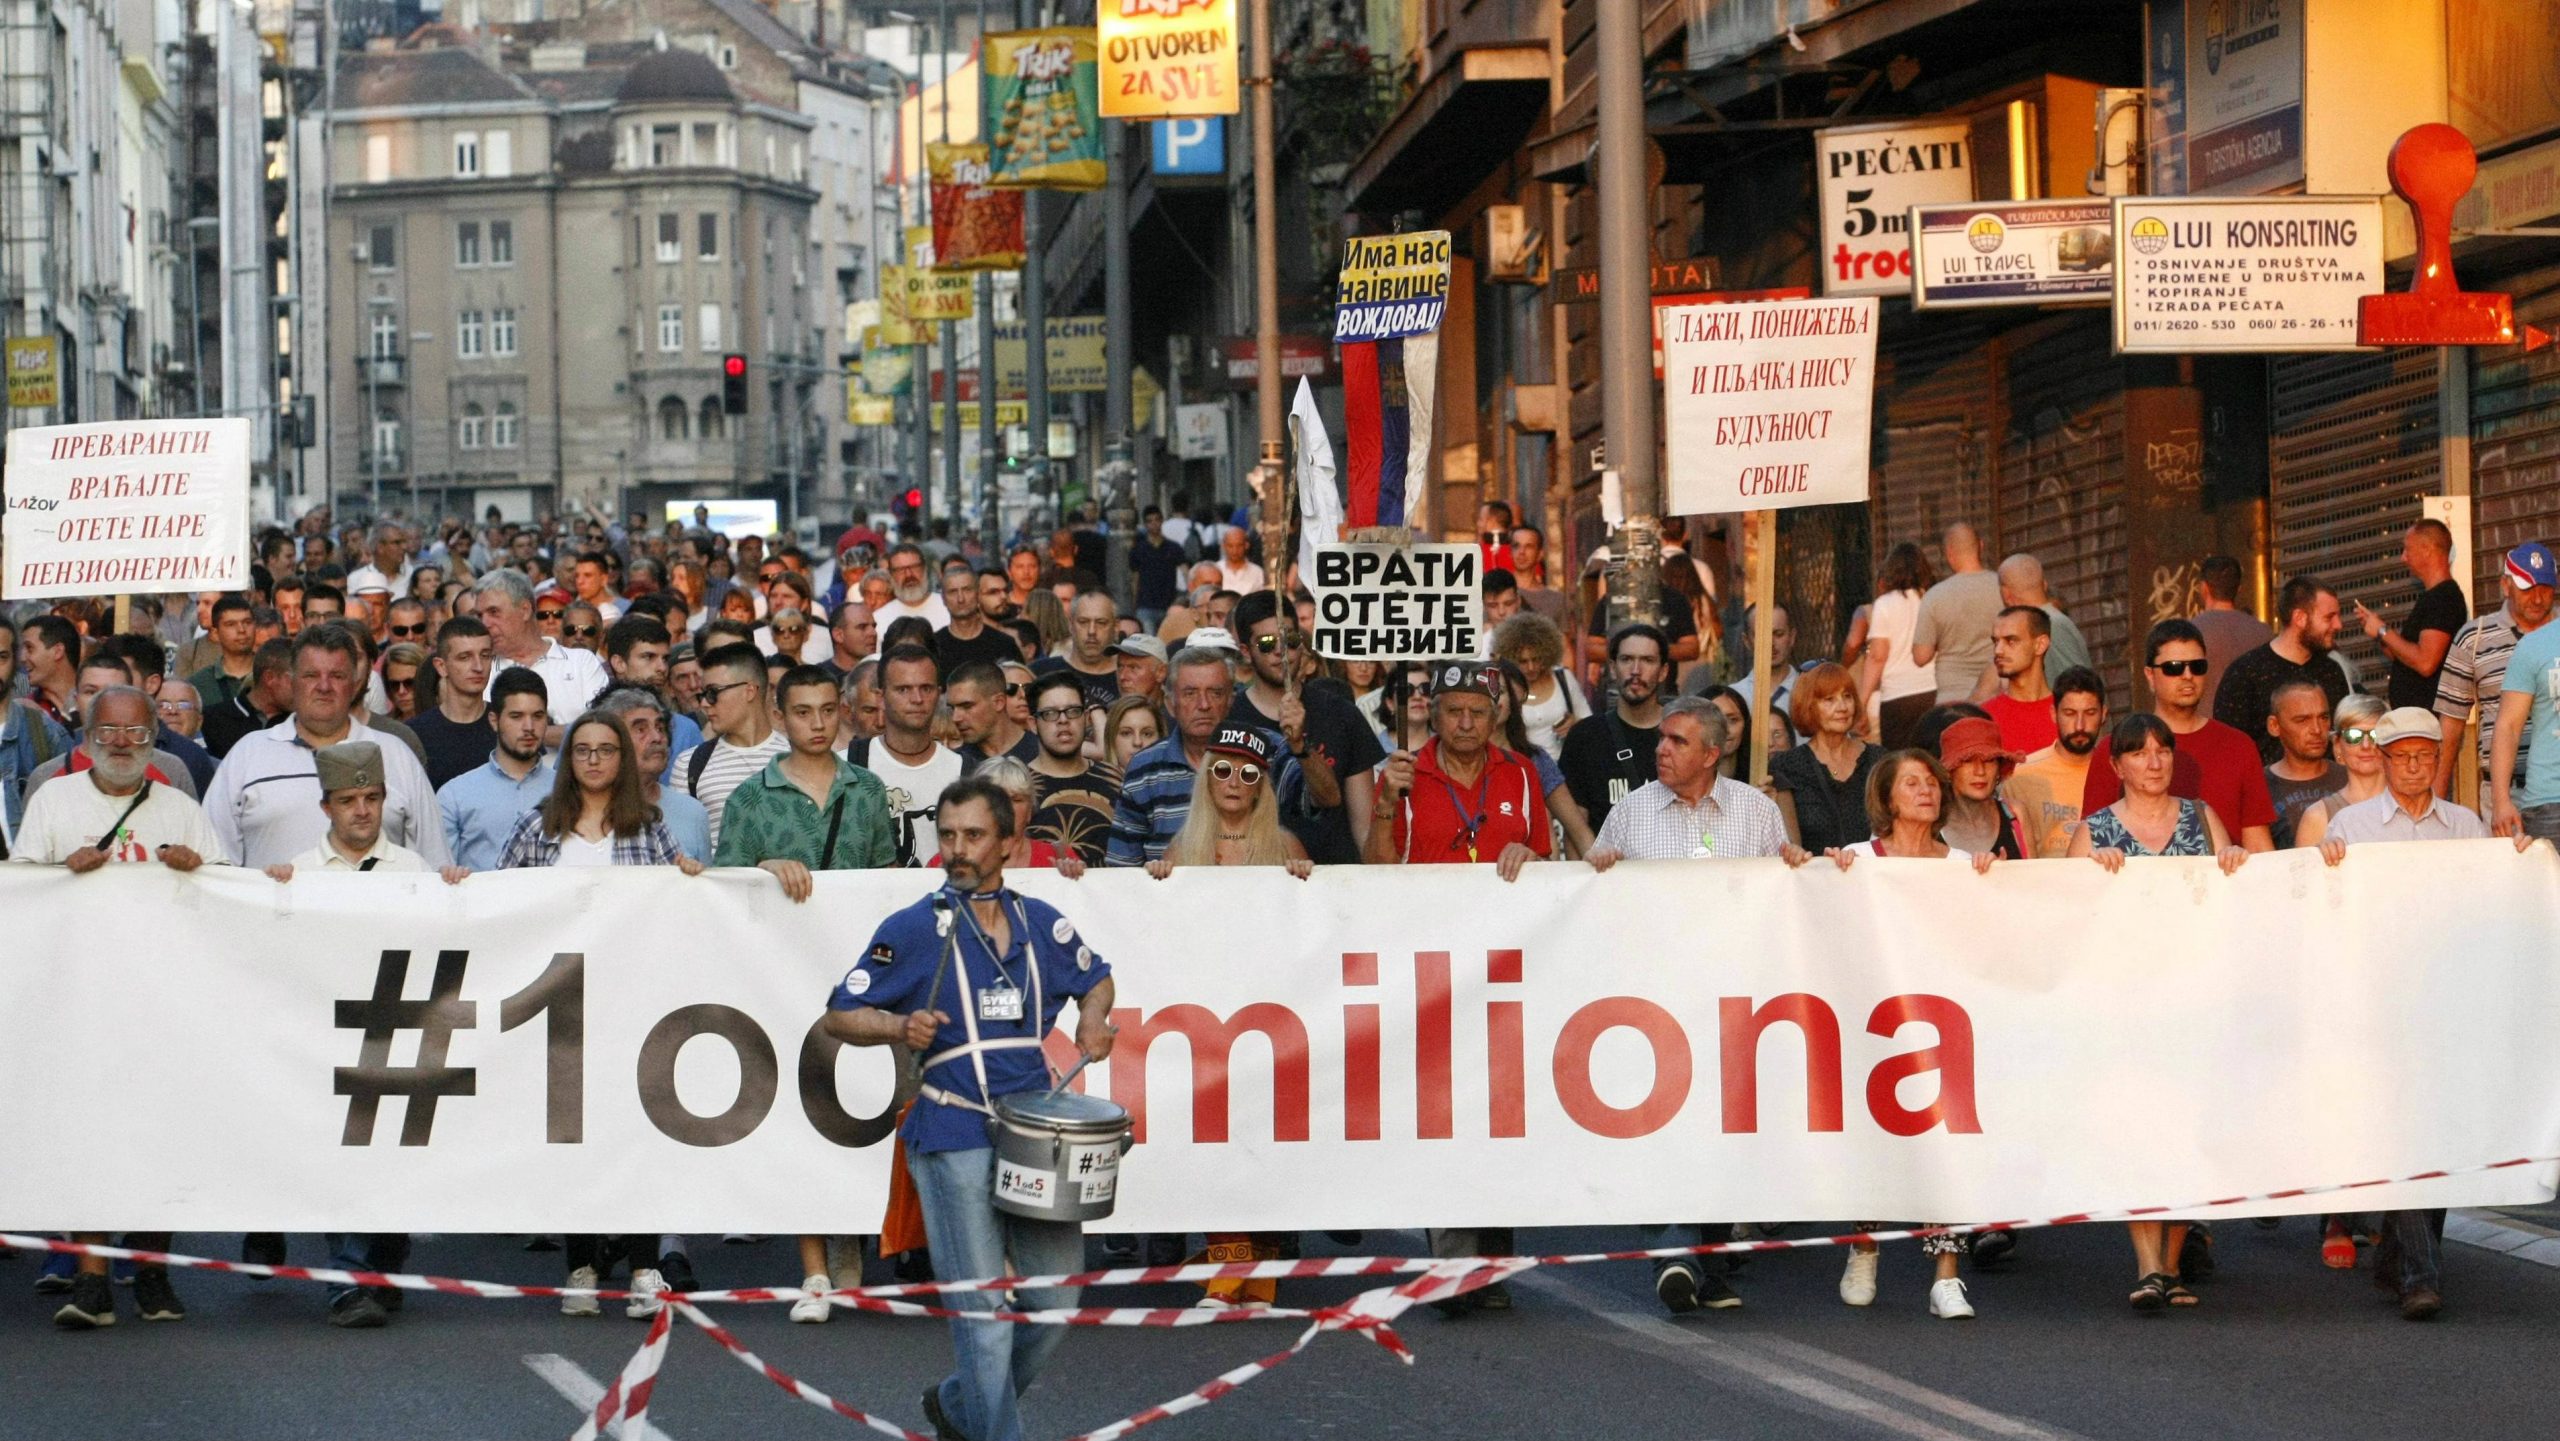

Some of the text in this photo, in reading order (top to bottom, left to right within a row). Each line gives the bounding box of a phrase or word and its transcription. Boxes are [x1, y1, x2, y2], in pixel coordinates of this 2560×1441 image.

[1108, 27, 1227, 63] OTVOREN
[1121, 63, 1222, 101] ZA SVE
[1167, 118, 1207, 168] P
[1829, 138, 1963, 178] PEČATI
[1844, 188, 1877, 237] 5
[2142, 222, 2157, 234] LT
[2174, 219, 2358, 248] LUI KONSALTING
[1343, 239, 1397, 271] Има
[1943, 253, 2036, 274] LUI TRAVEL
[2147, 256, 2338, 269] OSNIVANJE DRUŠTVA
[1338, 270, 1448, 304] највише
[2147, 270, 2366, 284] PROMENE U DRUŠTVIMA
[2147, 287, 2248, 298] KOPIRANJE
[2148, 301, 2211, 312] IZRADA
[1335, 301, 1443, 339] ВОЖДОВАЦ
[1675, 305, 1869, 345] ЛАЖИ, ПОНИЖЕЊА
[2134, 320, 2163, 330] 011/
[2166, 320, 2199, 330] 2620
[2211, 319, 2236, 330] 530
[2249, 319, 2276, 329] 060/
[2282, 318, 2298, 329] 26
[2309, 318, 2326, 329] 26
[1690, 357, 1857, 395] И ПЉАЧКА НИСУ
[51, 430, 211, 460] ПРЕВАРАНТИ
[1715, 409, 1833, 452] БУДУЋНОСТ
[68, 472, 191, 500] ВРАЋАЈТЕ
[1739, 463, 1810, 497] СРБИЈЕ
[8, 496, 60, 511] LAŽOV
[58, 514, 207, 542] ОТЕТЕ ПАРЕ
[20, 555, 236, 586] ПЕНЗИОНЕРИМА!
[1316, 551, 1474, 587] ВРАТИ
[1321, 592, 1470, 625] ОТЕТЕ
[1315, 627, 1475, 655] ПЕНЗИЈЕ
[983, 995, 1019, 1006] БУКА
[983, 1006, 1009, 1016] БРЕ
